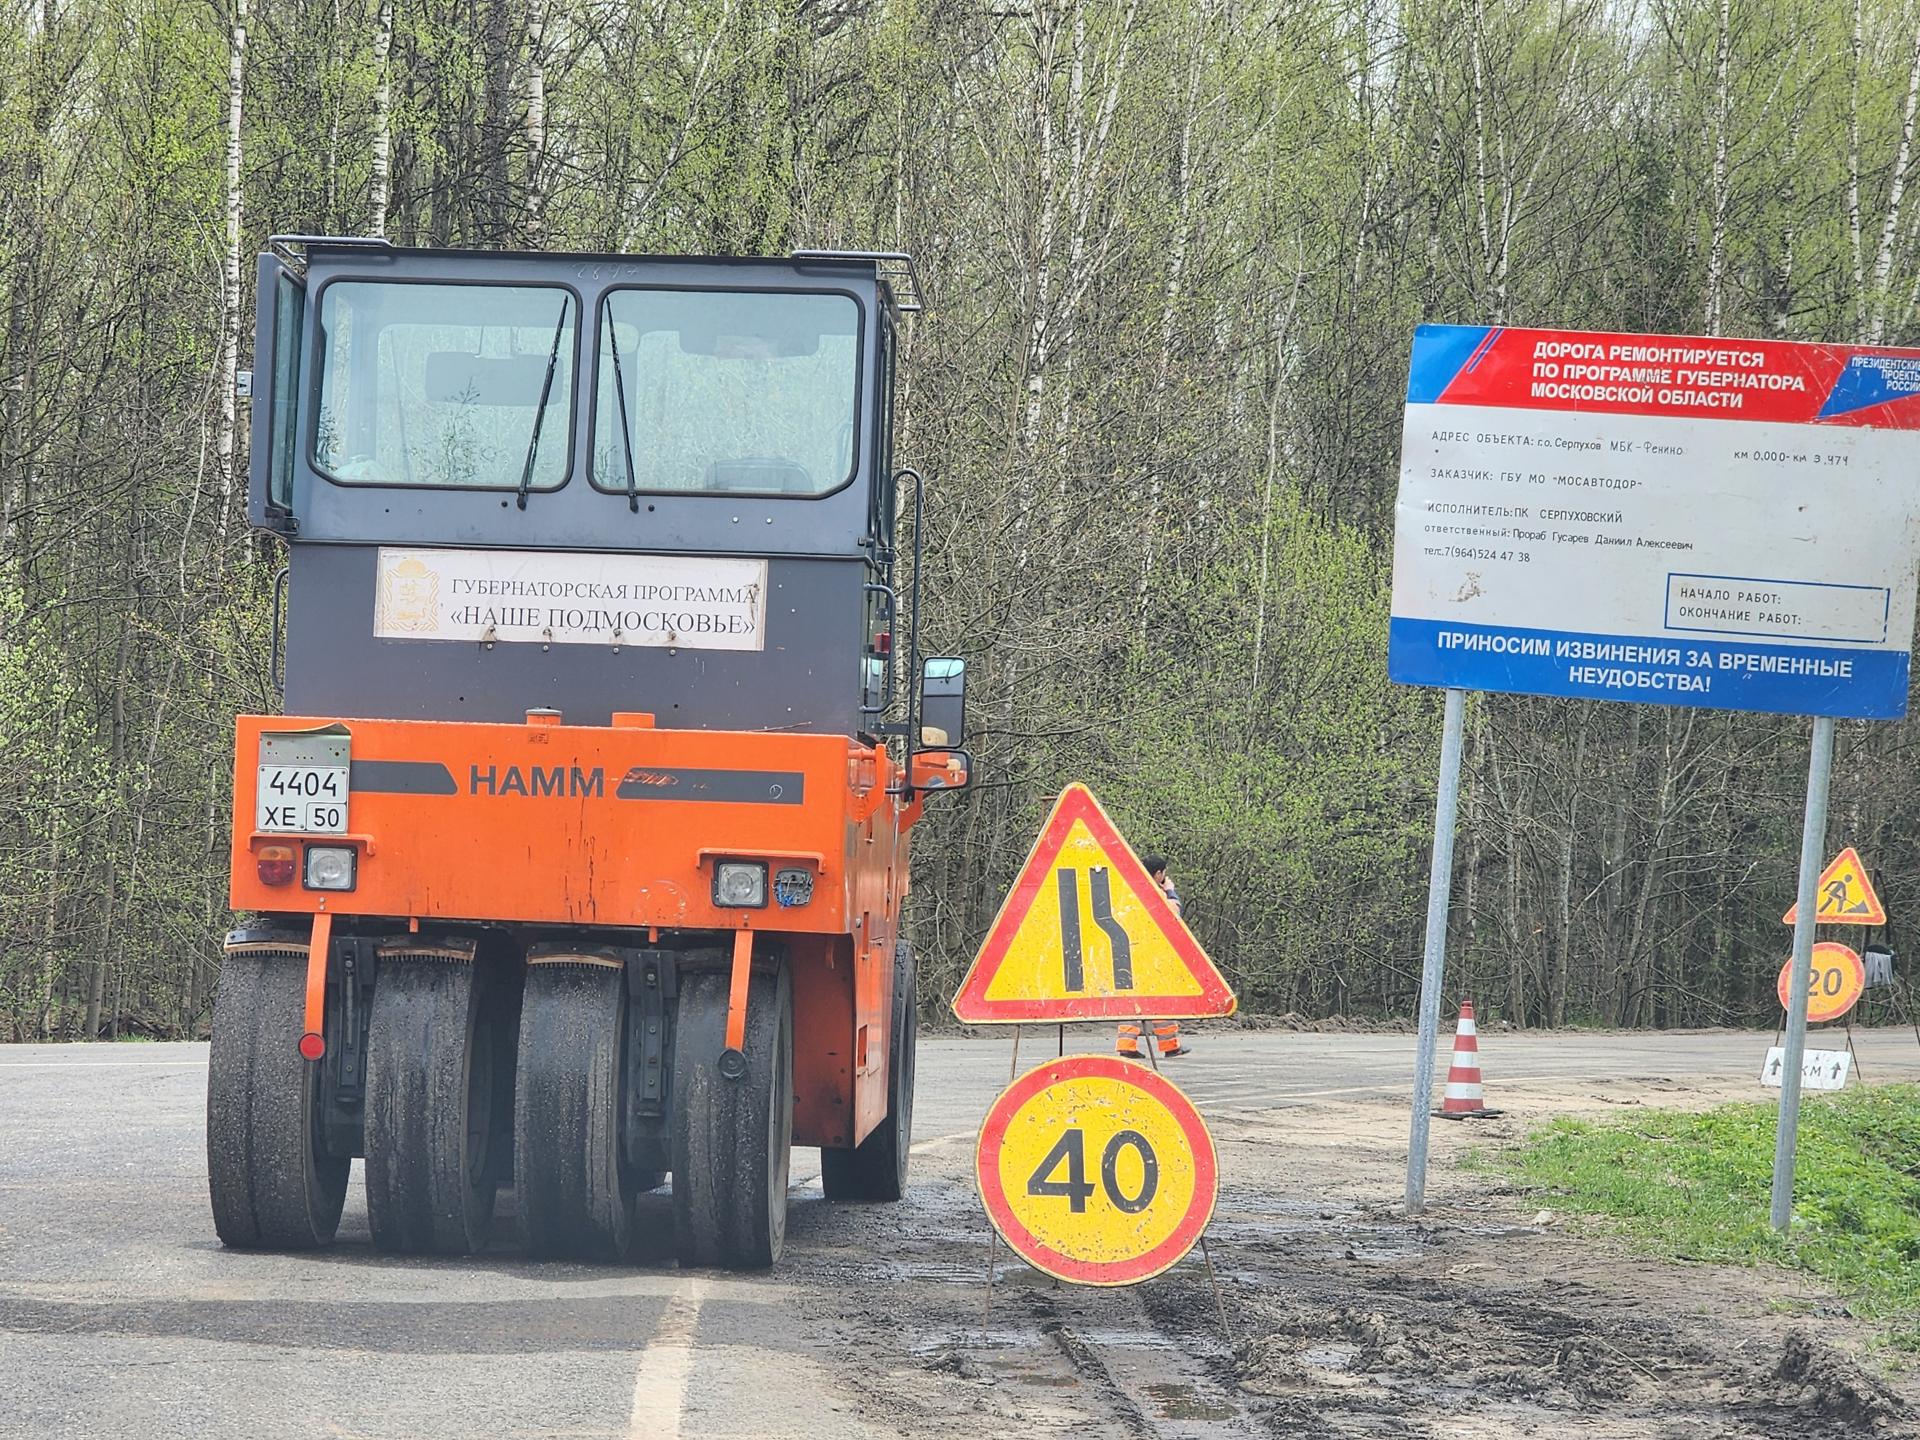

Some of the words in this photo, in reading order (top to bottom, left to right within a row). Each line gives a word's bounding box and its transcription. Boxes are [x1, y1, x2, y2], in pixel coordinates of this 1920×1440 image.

[1533, 341, 1605, 360] ДОРОГА
[1609, 345, 1764, 368] РЕМОНТИРУЕТСЯ
[1532, 362, 1559, 378] ПО
[1563, 364, 1673, 385] ПРОГРАММЕ
[1676, 369, 1806, 392] ГУБЕРНАТОРА
[1531, 382, 1654, 404] МОСКОВСКОЙ
[1657, 389, 1744, 409] ОБЛАСТИ
[1431, 431, 1470, 443] АДРЕС
[1476, 433, 1534, 446] ОБЪЕКТА:
[1430, 468, 1494, 481] ЗАКАЗЧИК:
[1500, 472, 1522, 482] ГБУ
[1529, 474, 1546, 484] МО
[1539, 509, 1623, 523] СЕРПУХОВСКИЙ
[1552, 531, 1589, 544] Гусарев
[1595, 534, 1633, 547] Даниил
[1636, 537, 1693, 550] Алексеевич
[1500, 551, 1514, 562] 47
[1518, 551, 1531, 563] 38
[451, 578, 627, 600] ГУБЕРНАТОРСКАЯ
[633, 584, 756, 604] ПРОГРАММА
[1680, 587, 1730, 601] НАЧАЛО
[1737, 592, 1782, 605] РАБОТ:
[450, 605, 541, 627] «НАШЕ
[548, 608, 756, 634] ПОДМОСКОВЬЕ»
[1679, 606, 1751, 622] ОКОНЧАНИЕ
[1758, 613, 1802, 625] РАБОТ:
[1438, 631, 1550, 656] ПРИНОСИМ
[1555, 641, 1681, 666] ИЗВИНЕНИЯ
[1685, 650, 1713, 669] ЗА
[1718, 653, 1853, 677] ВРЕМЕННЫЕ
[1569, 666, 1711, 692] НЕУДОБСТВА!
[269, 770, 337, 798] 4404
[469, 765, 604, 798] HAMM
[264, 806, 297, 827] ХЕ
[313, 807, 340, 828] 50
[1026, 1128, 1159, 1214] 40
